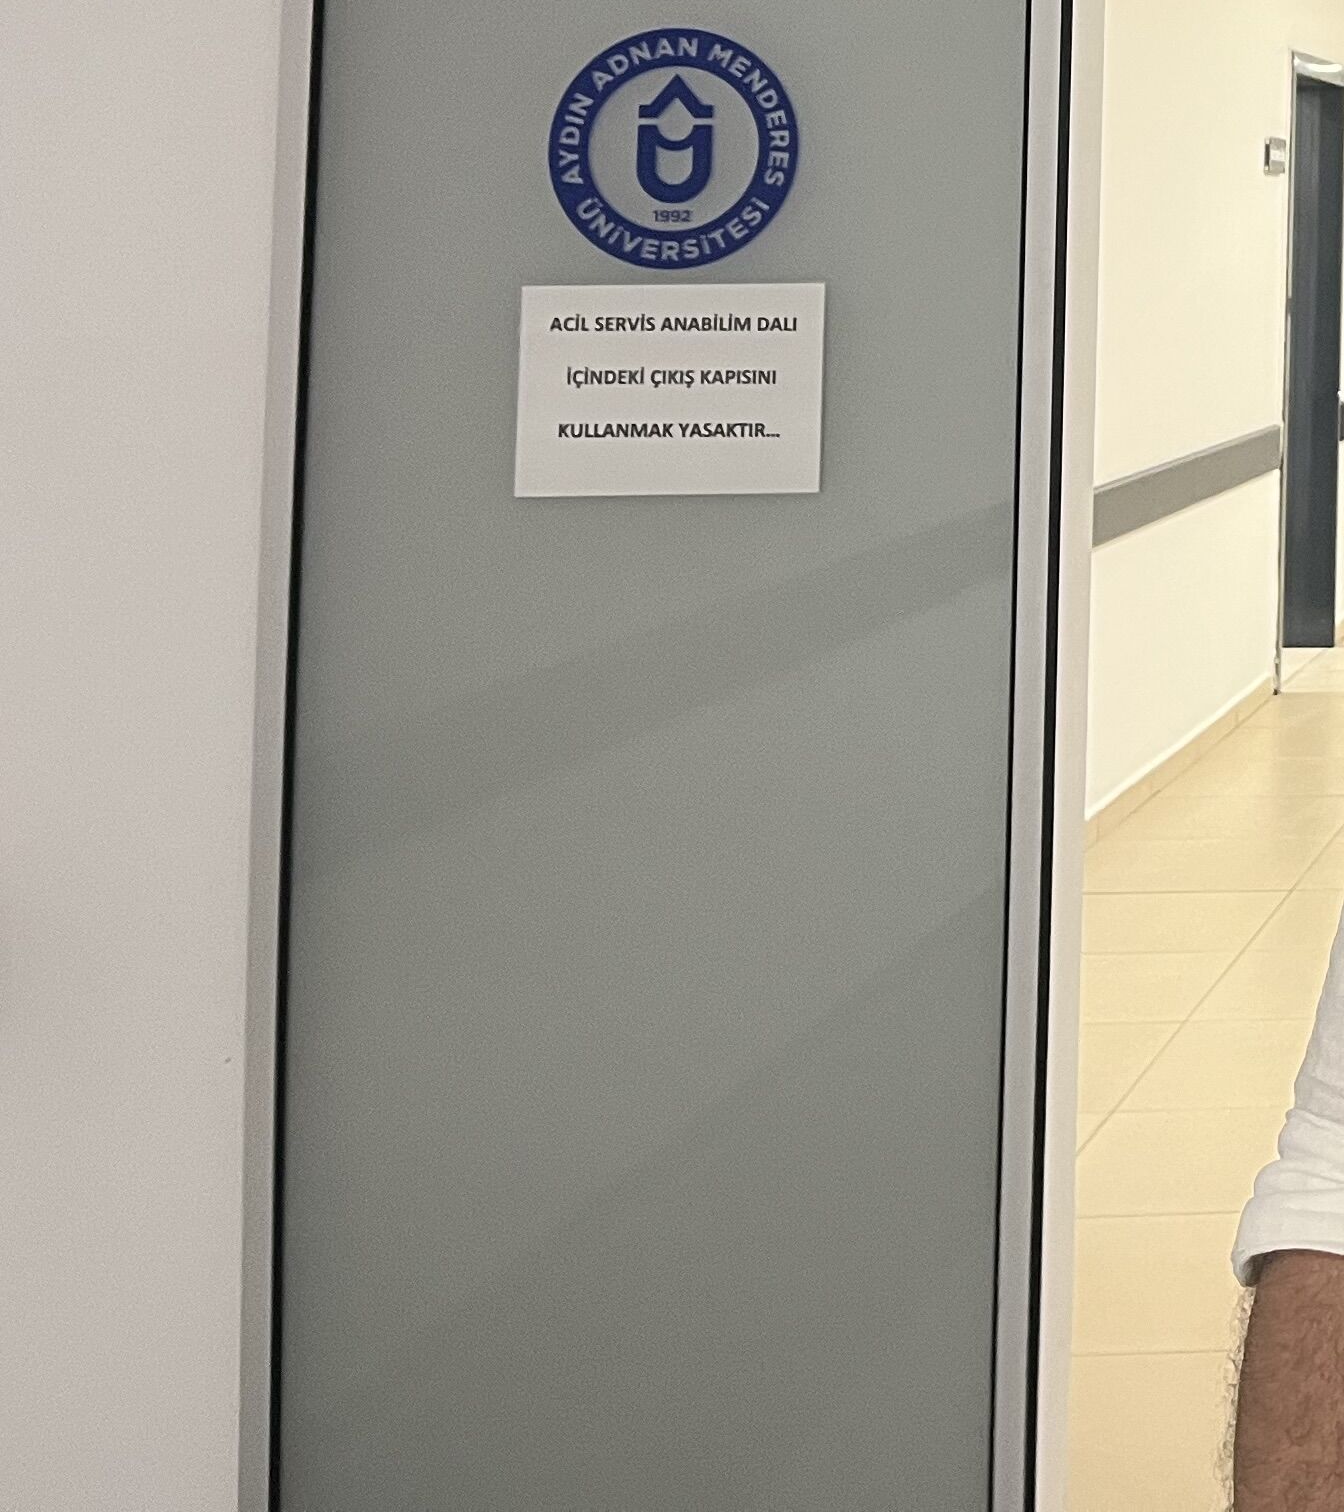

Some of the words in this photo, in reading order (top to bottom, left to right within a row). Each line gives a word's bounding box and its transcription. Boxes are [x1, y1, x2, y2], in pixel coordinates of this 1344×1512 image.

[558, 92, 594, 186] AYDIN
[591, 37, 699, 91] ADNAN
[707, 43, 790, 188] MENDERES
[652, 209, 692, 223] 1992
[550, 314, 589, 332] ACİL
[595, 314, 655, 332] SERVİS
[660, 314, 751, 332] ANABİLİM
[757, 316, 797, 332] DALI
[567, 366, 645, 388] İÇİNDEKİ
[650, 369, 695, 388] ÇIKIŞ
[700, 369, 777, 385] KAPISINI
[558, 423, 674, 438] KULLANMAK
[679, 422, 781, 438] YASAKTIR...
